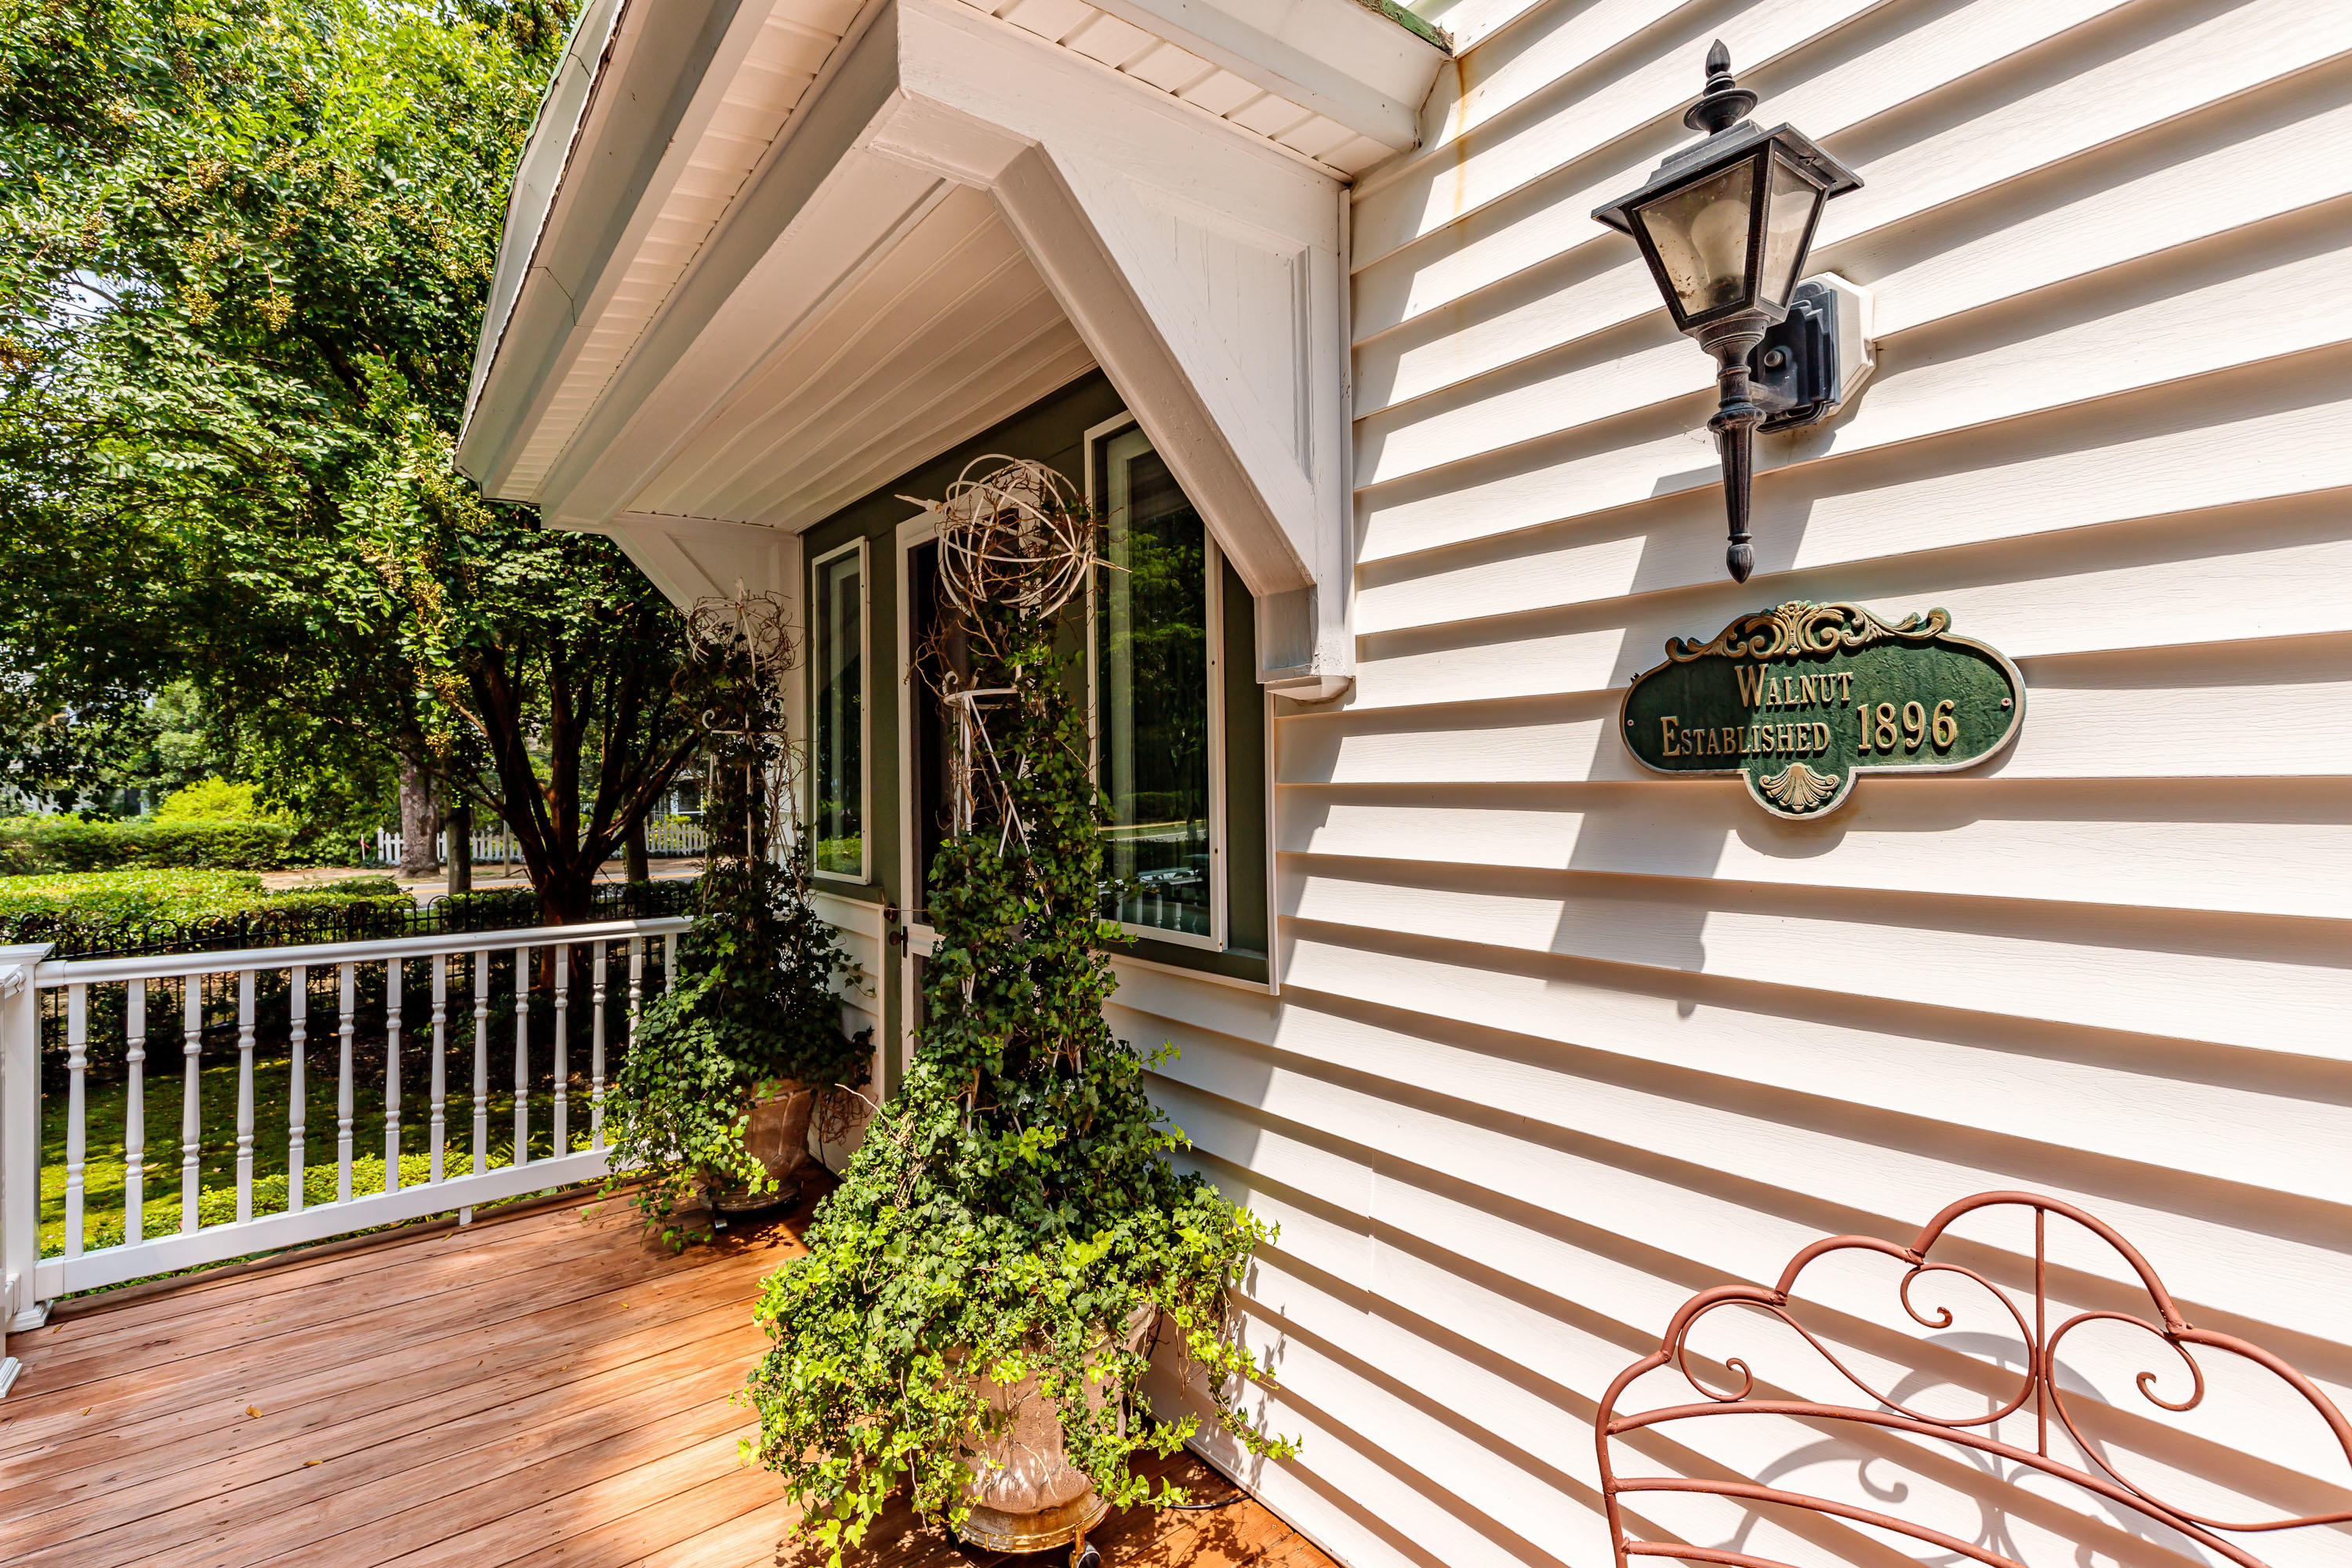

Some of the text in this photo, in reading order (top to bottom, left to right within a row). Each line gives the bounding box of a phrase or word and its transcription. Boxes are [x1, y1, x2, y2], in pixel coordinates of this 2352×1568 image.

[1734, 663, 1853, 707] WALNUT
[1661, 699, 1957, 757] ESTABLISHED 1896
